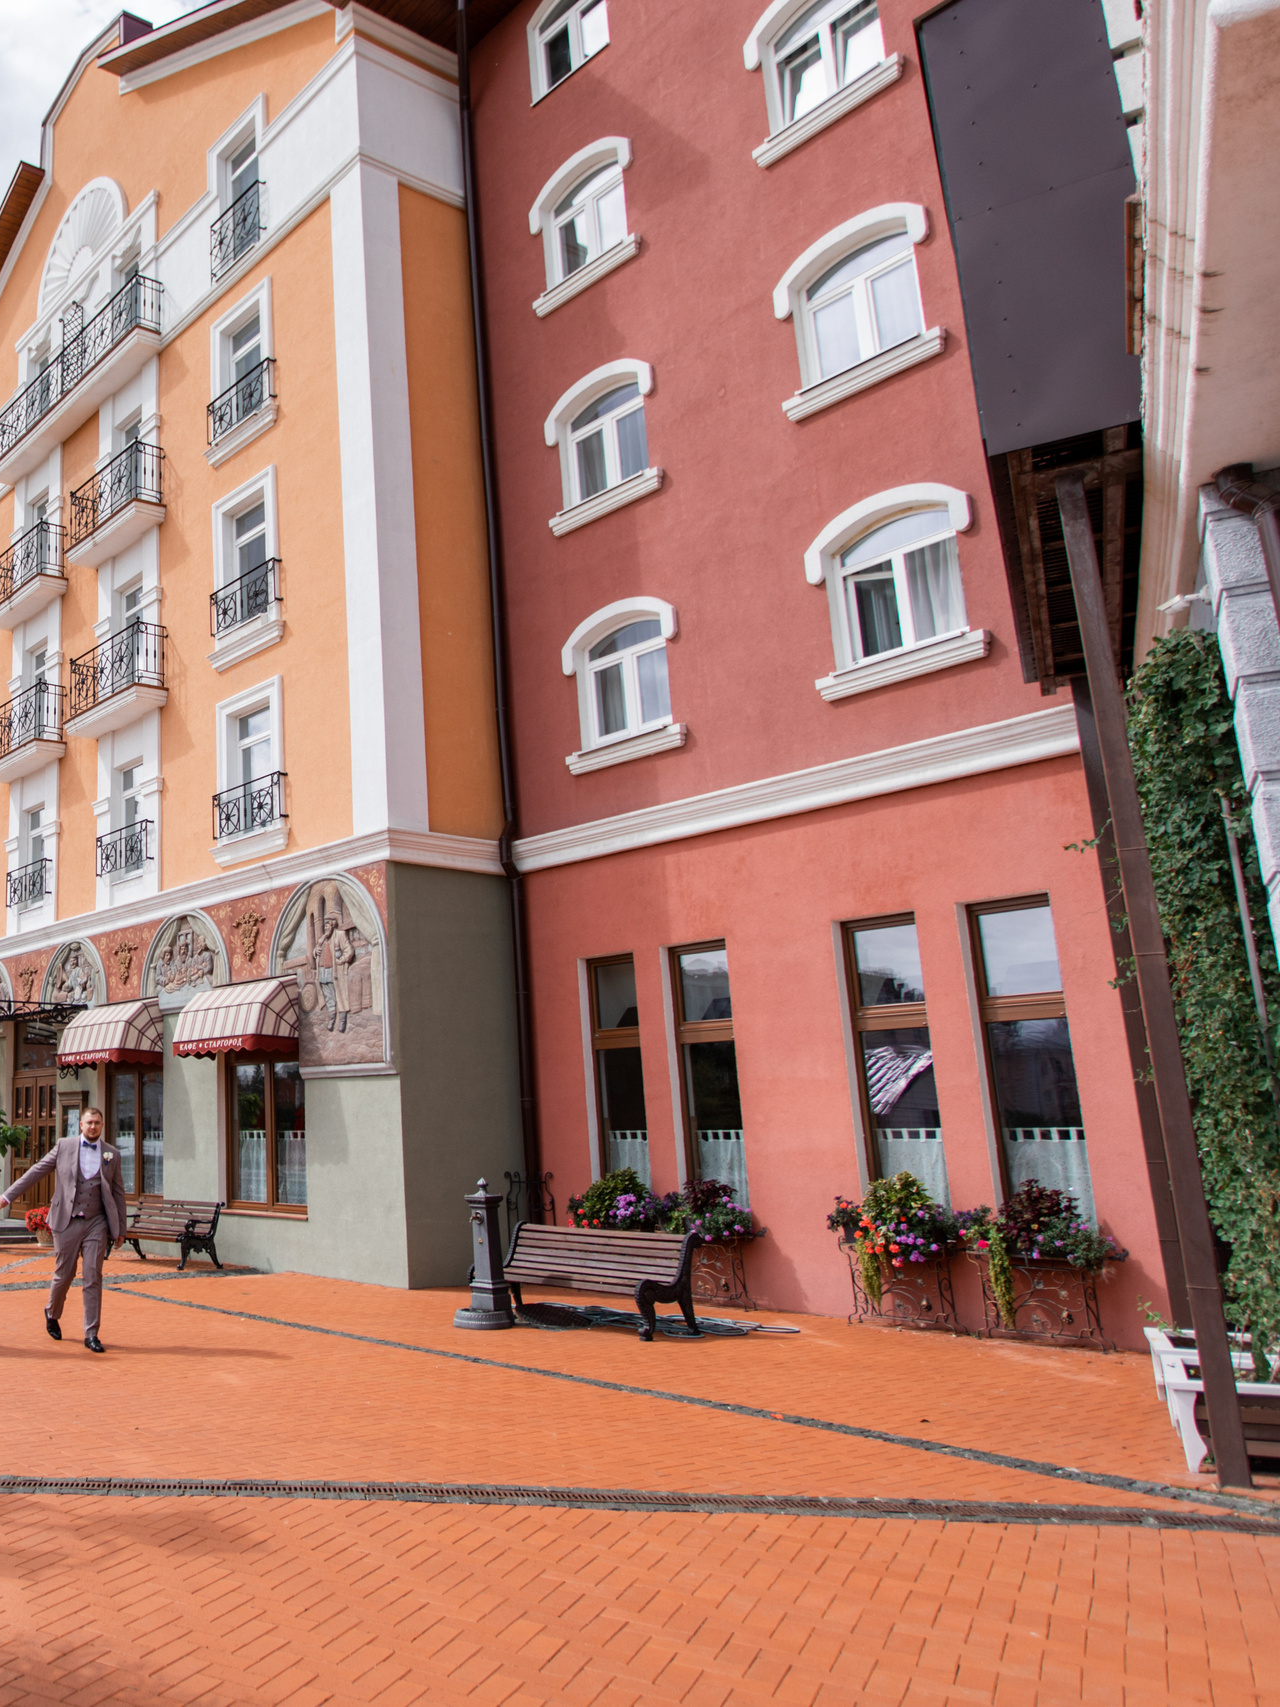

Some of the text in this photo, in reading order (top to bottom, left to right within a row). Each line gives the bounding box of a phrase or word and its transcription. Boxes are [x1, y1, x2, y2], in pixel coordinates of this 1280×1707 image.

[179, 1038, 242, 1051] КАФЕ СТАРГОРОД
[80, 1051, 109, 1060] СТАРГОРОД
